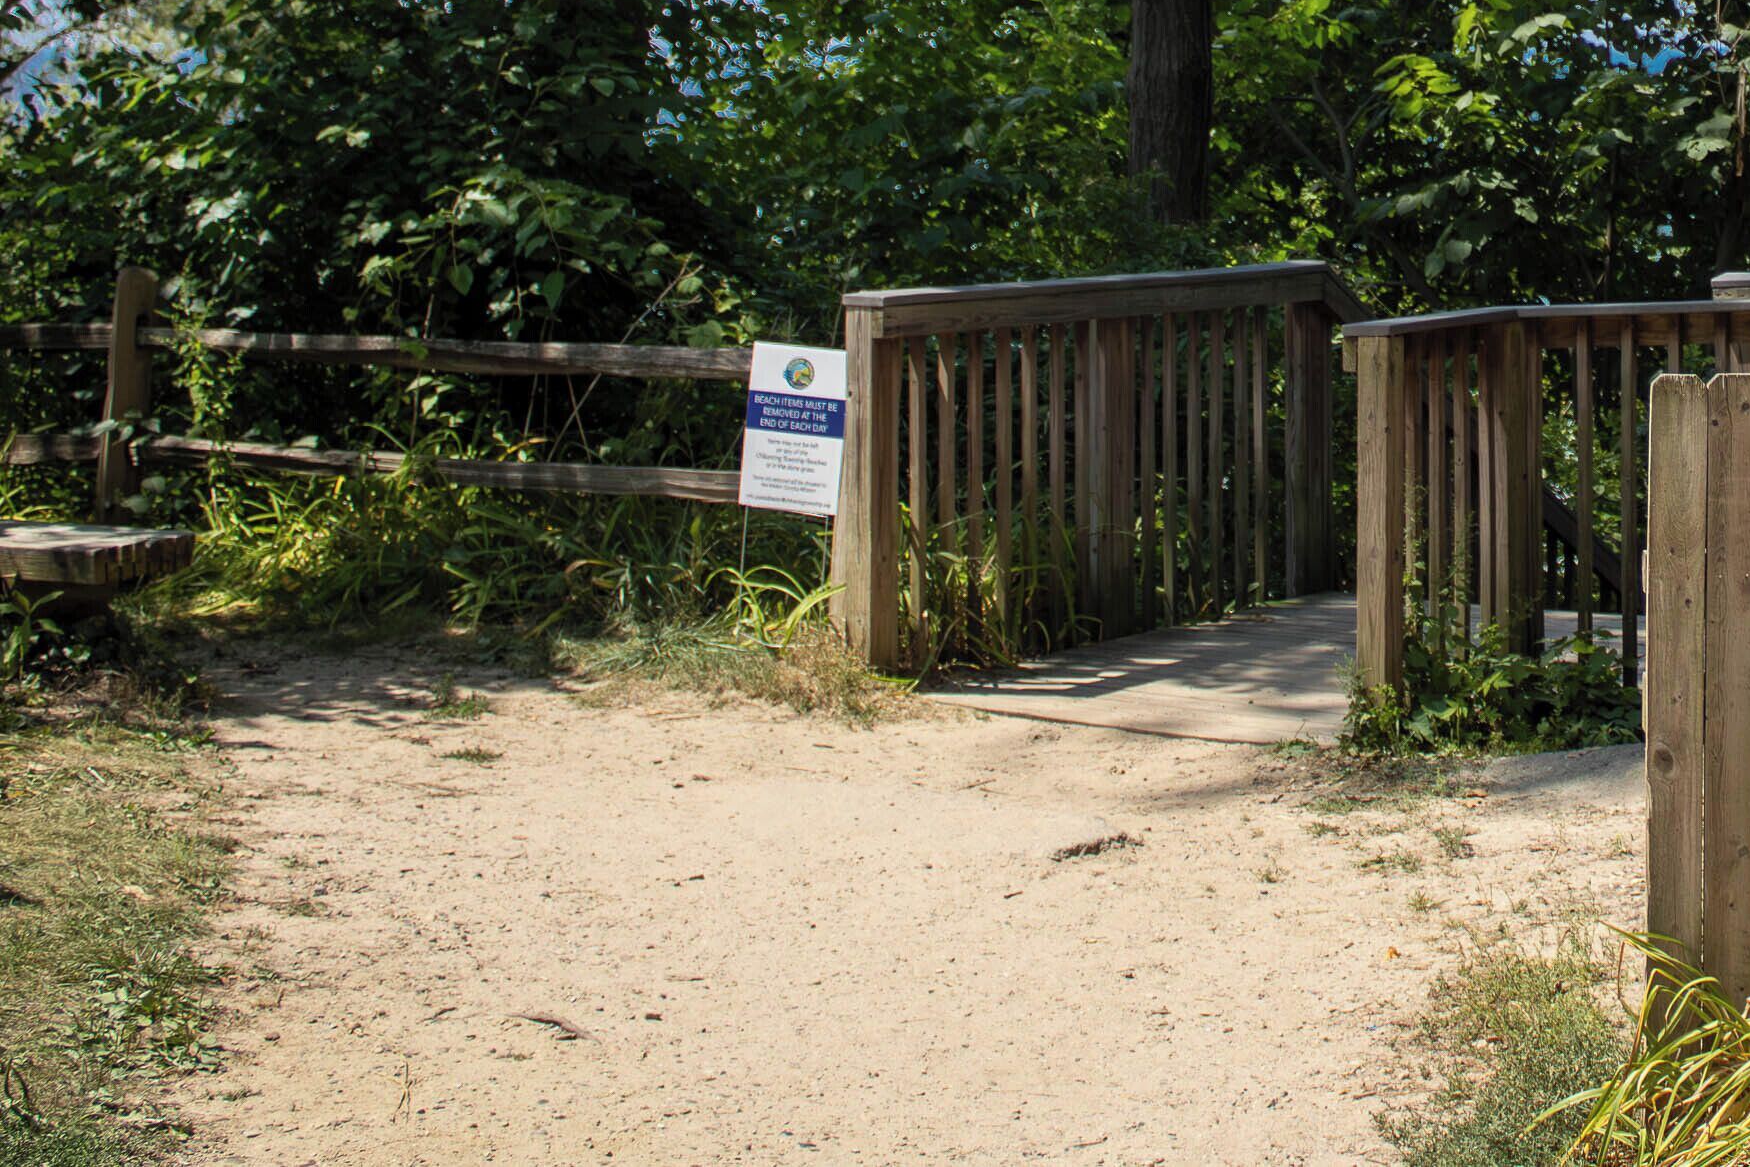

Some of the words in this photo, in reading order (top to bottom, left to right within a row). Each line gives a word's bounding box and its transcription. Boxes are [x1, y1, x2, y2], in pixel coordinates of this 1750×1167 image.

[755, 394, 780, 405] BEACH
[781, 397, 803, 408] ITEMS
[805, 400, 827, 411] MUST
[827, 402, 839, 412] BE
[763, 406, 800, 419] REMOVED
[801, 411, 811, 420] AT
[812, 412, 827, 422] THE
[760, 417, 777, 427] END
[778, 419, 789, 429] OF
[790, 421, 811, 432] EACH
[812, 423, 828, 433] DAY
